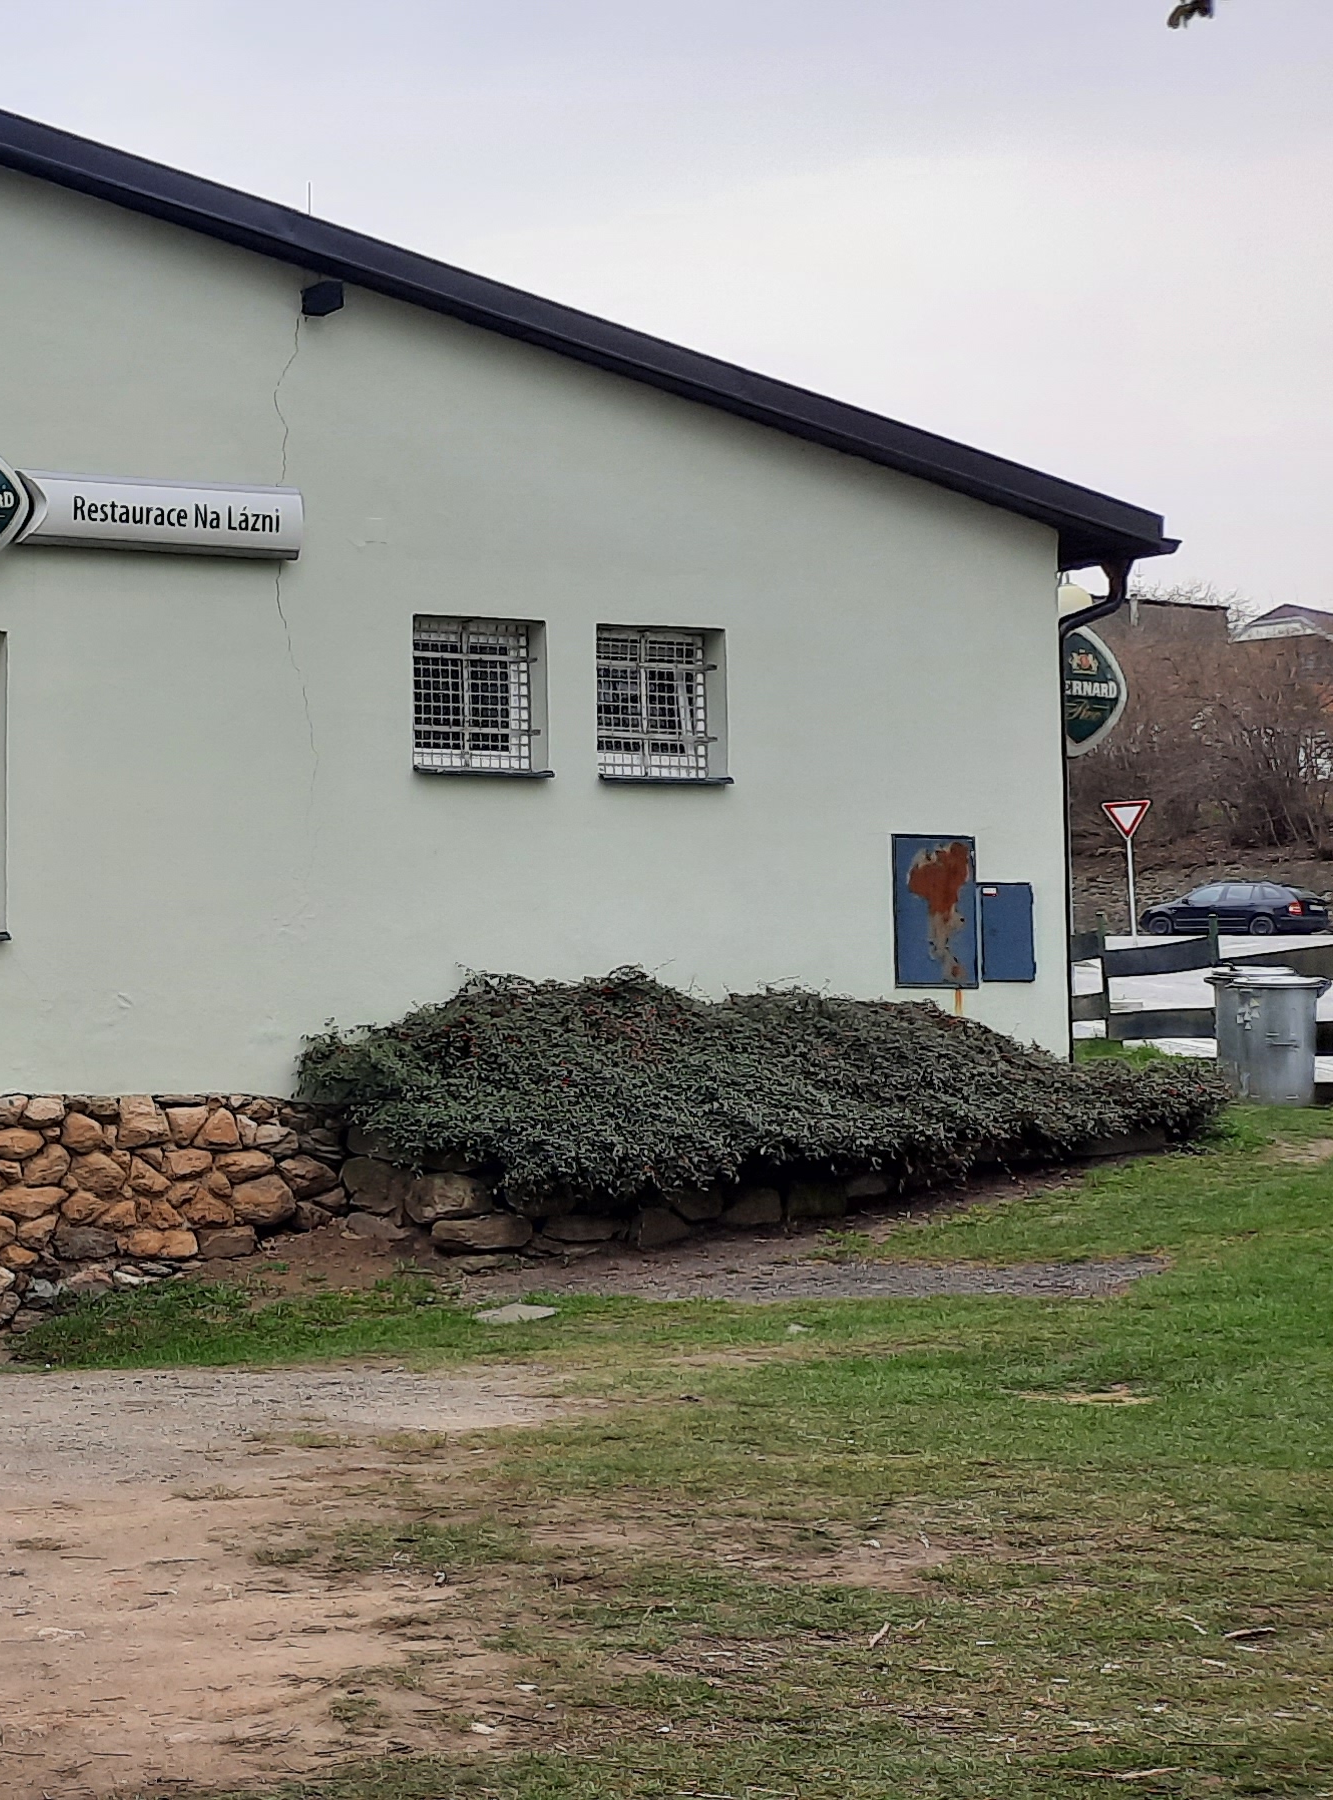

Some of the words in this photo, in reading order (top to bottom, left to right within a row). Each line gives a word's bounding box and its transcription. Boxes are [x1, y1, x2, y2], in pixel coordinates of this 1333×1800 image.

[72, 495, 188, 528] Restaurace
[194, 503, 220, 529] Na
[227, 505, 280, 533] Lázni
[1065, 681, 1117, 698] ERNARD
